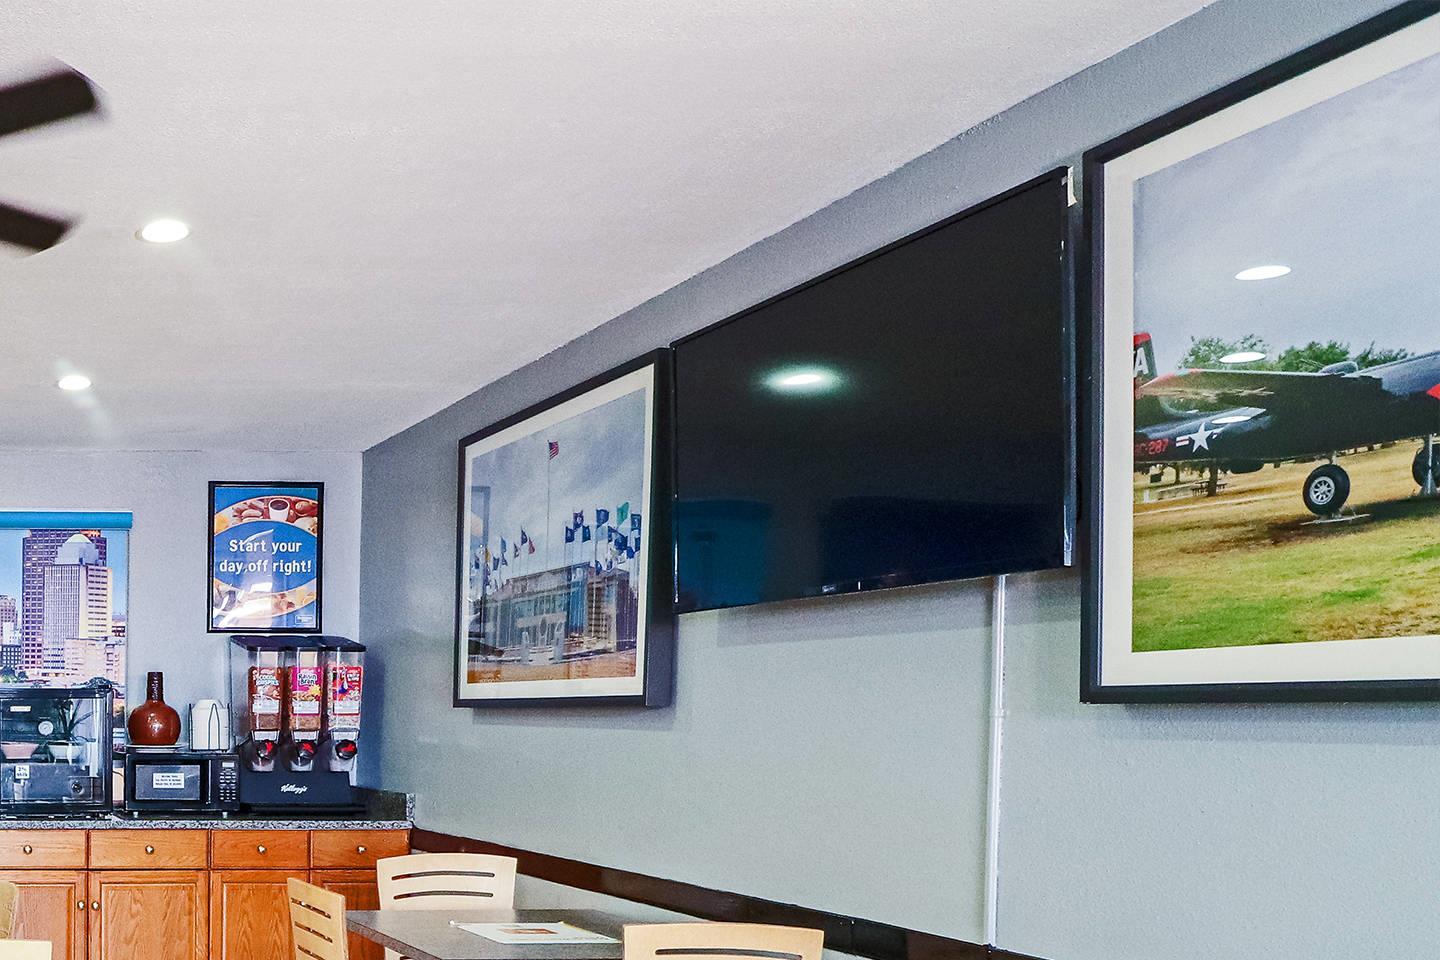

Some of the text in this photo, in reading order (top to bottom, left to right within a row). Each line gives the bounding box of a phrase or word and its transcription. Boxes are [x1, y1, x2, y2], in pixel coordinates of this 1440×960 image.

[1133, 347, 1149, 376] A
[229, 539, 302, 554] Start your
[248, 560, 268, 573] off
[272, 560, 312, 575] right!
